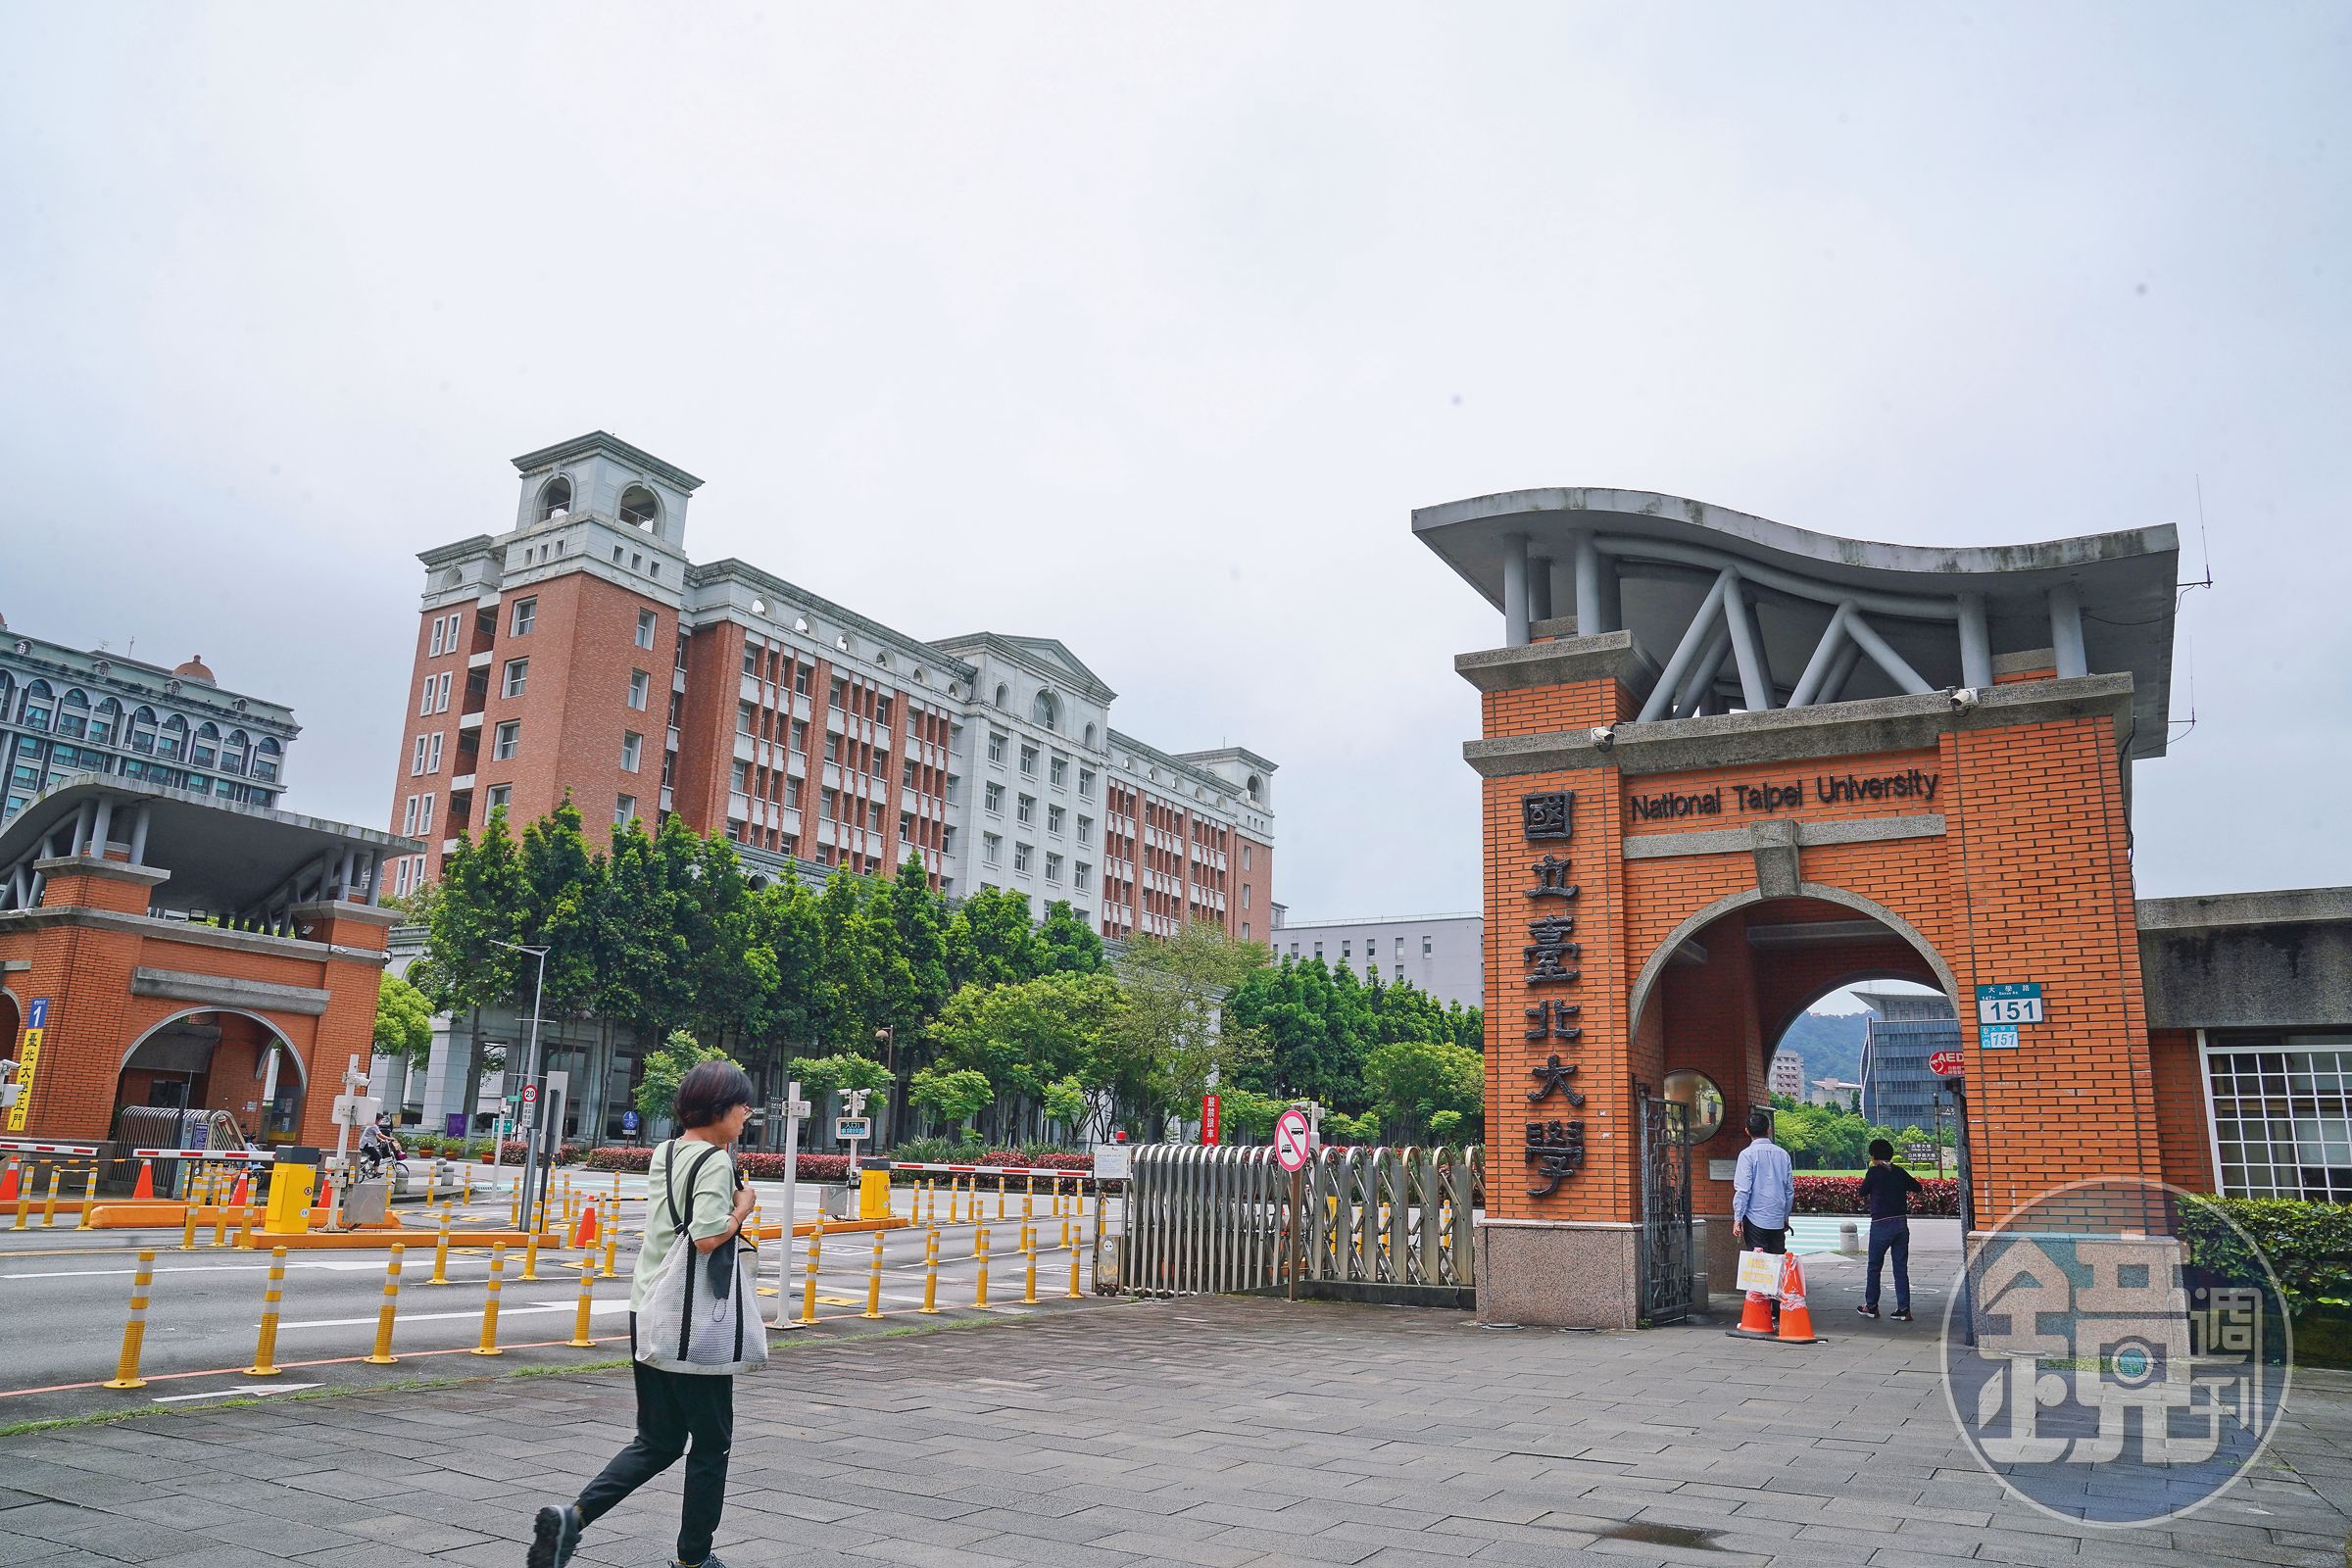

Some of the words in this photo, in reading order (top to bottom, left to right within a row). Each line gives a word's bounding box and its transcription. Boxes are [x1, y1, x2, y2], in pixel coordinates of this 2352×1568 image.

[1631, 785, 1721, 821] National
[1732, 777, 1803, 812] Taipei
[1816, 767, 1938, 804] University
[1523, 789, 1585, 1197] 國立臺北大學
[1987, 984, 2030, 993] 大學路
[33, 1005, 42, 1027] 1
[1990, 1001, 2034, 1021] 151
[1992, 1033, 2015, 1046] 151
[1937, 1053, 1964, 1063] AED
[11, 1032, 38, 1128] 臺北大學正門
